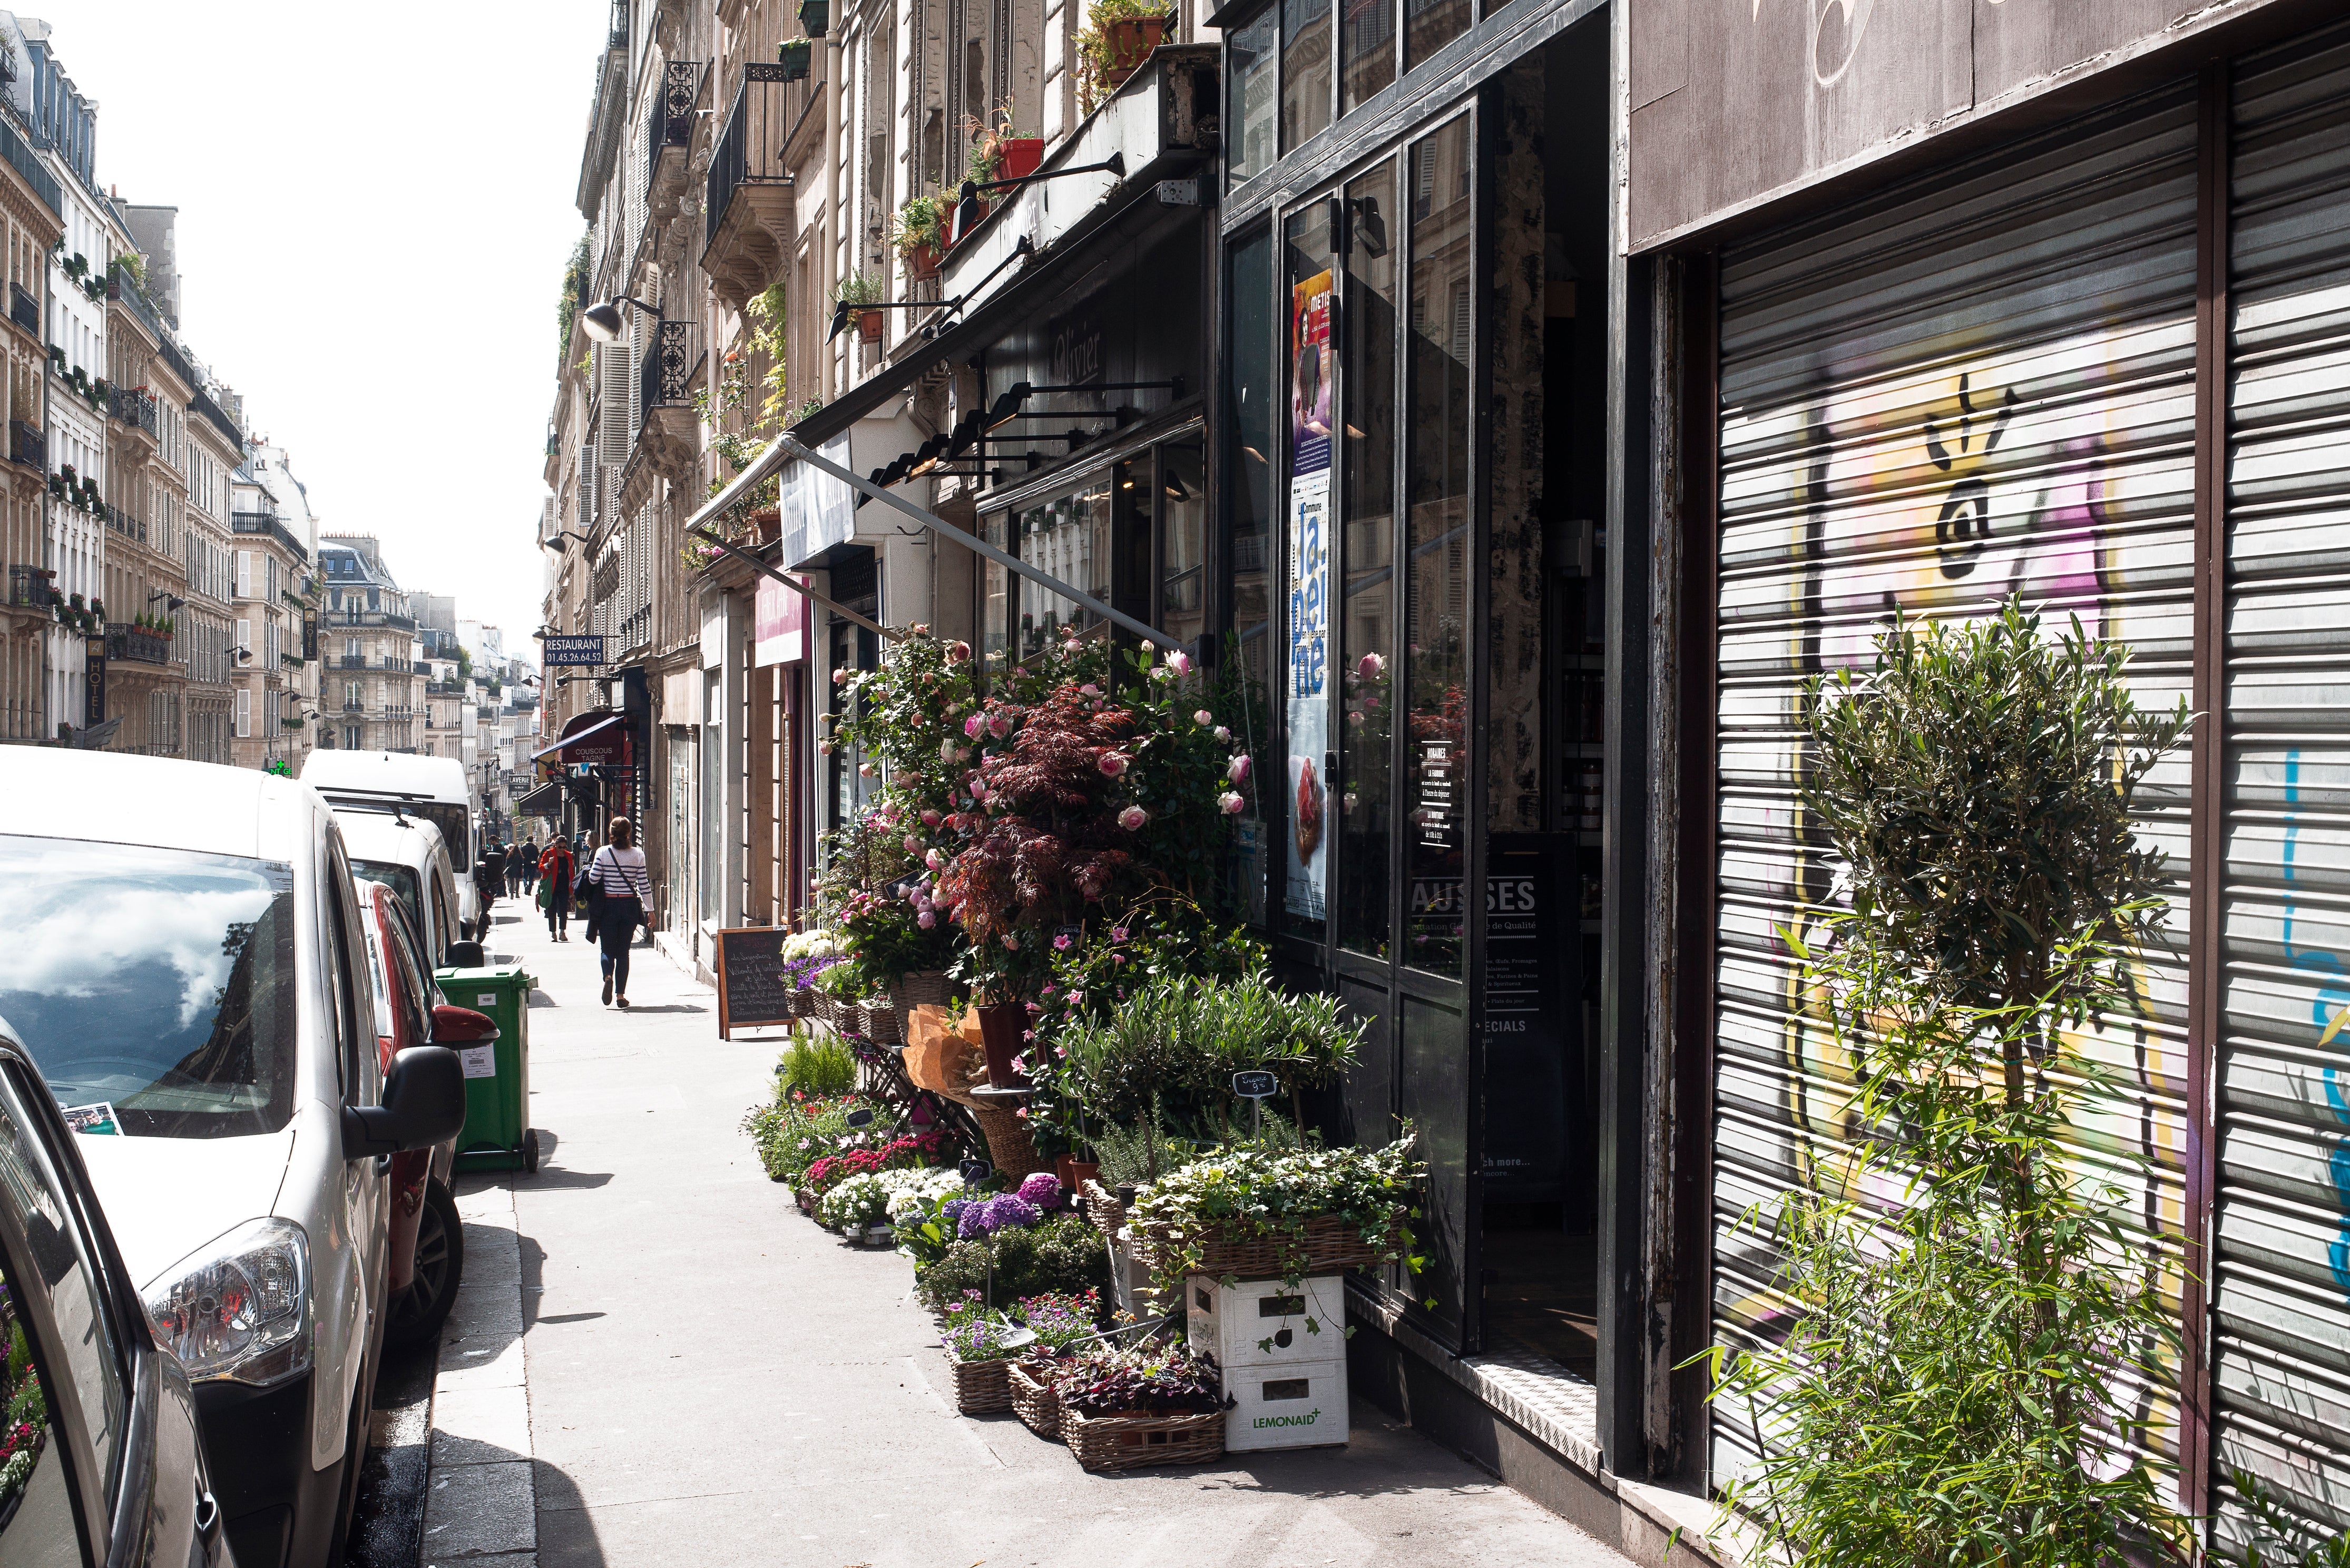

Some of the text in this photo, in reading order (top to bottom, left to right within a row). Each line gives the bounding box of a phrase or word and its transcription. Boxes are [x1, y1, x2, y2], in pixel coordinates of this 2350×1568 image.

[1311, 290, 1330, 313] METIS
[1303, 502, 1321, 514] Commune
[546, 639, 601, 650] RESTAURANT
[547, 653, 601, 662] 01.45.26.64.52
[90, 662, 101, 718] HOTEL
[1427, 747, 1446, 759] HORAIRES
[1504, 921, 1536, 930] Qualité
